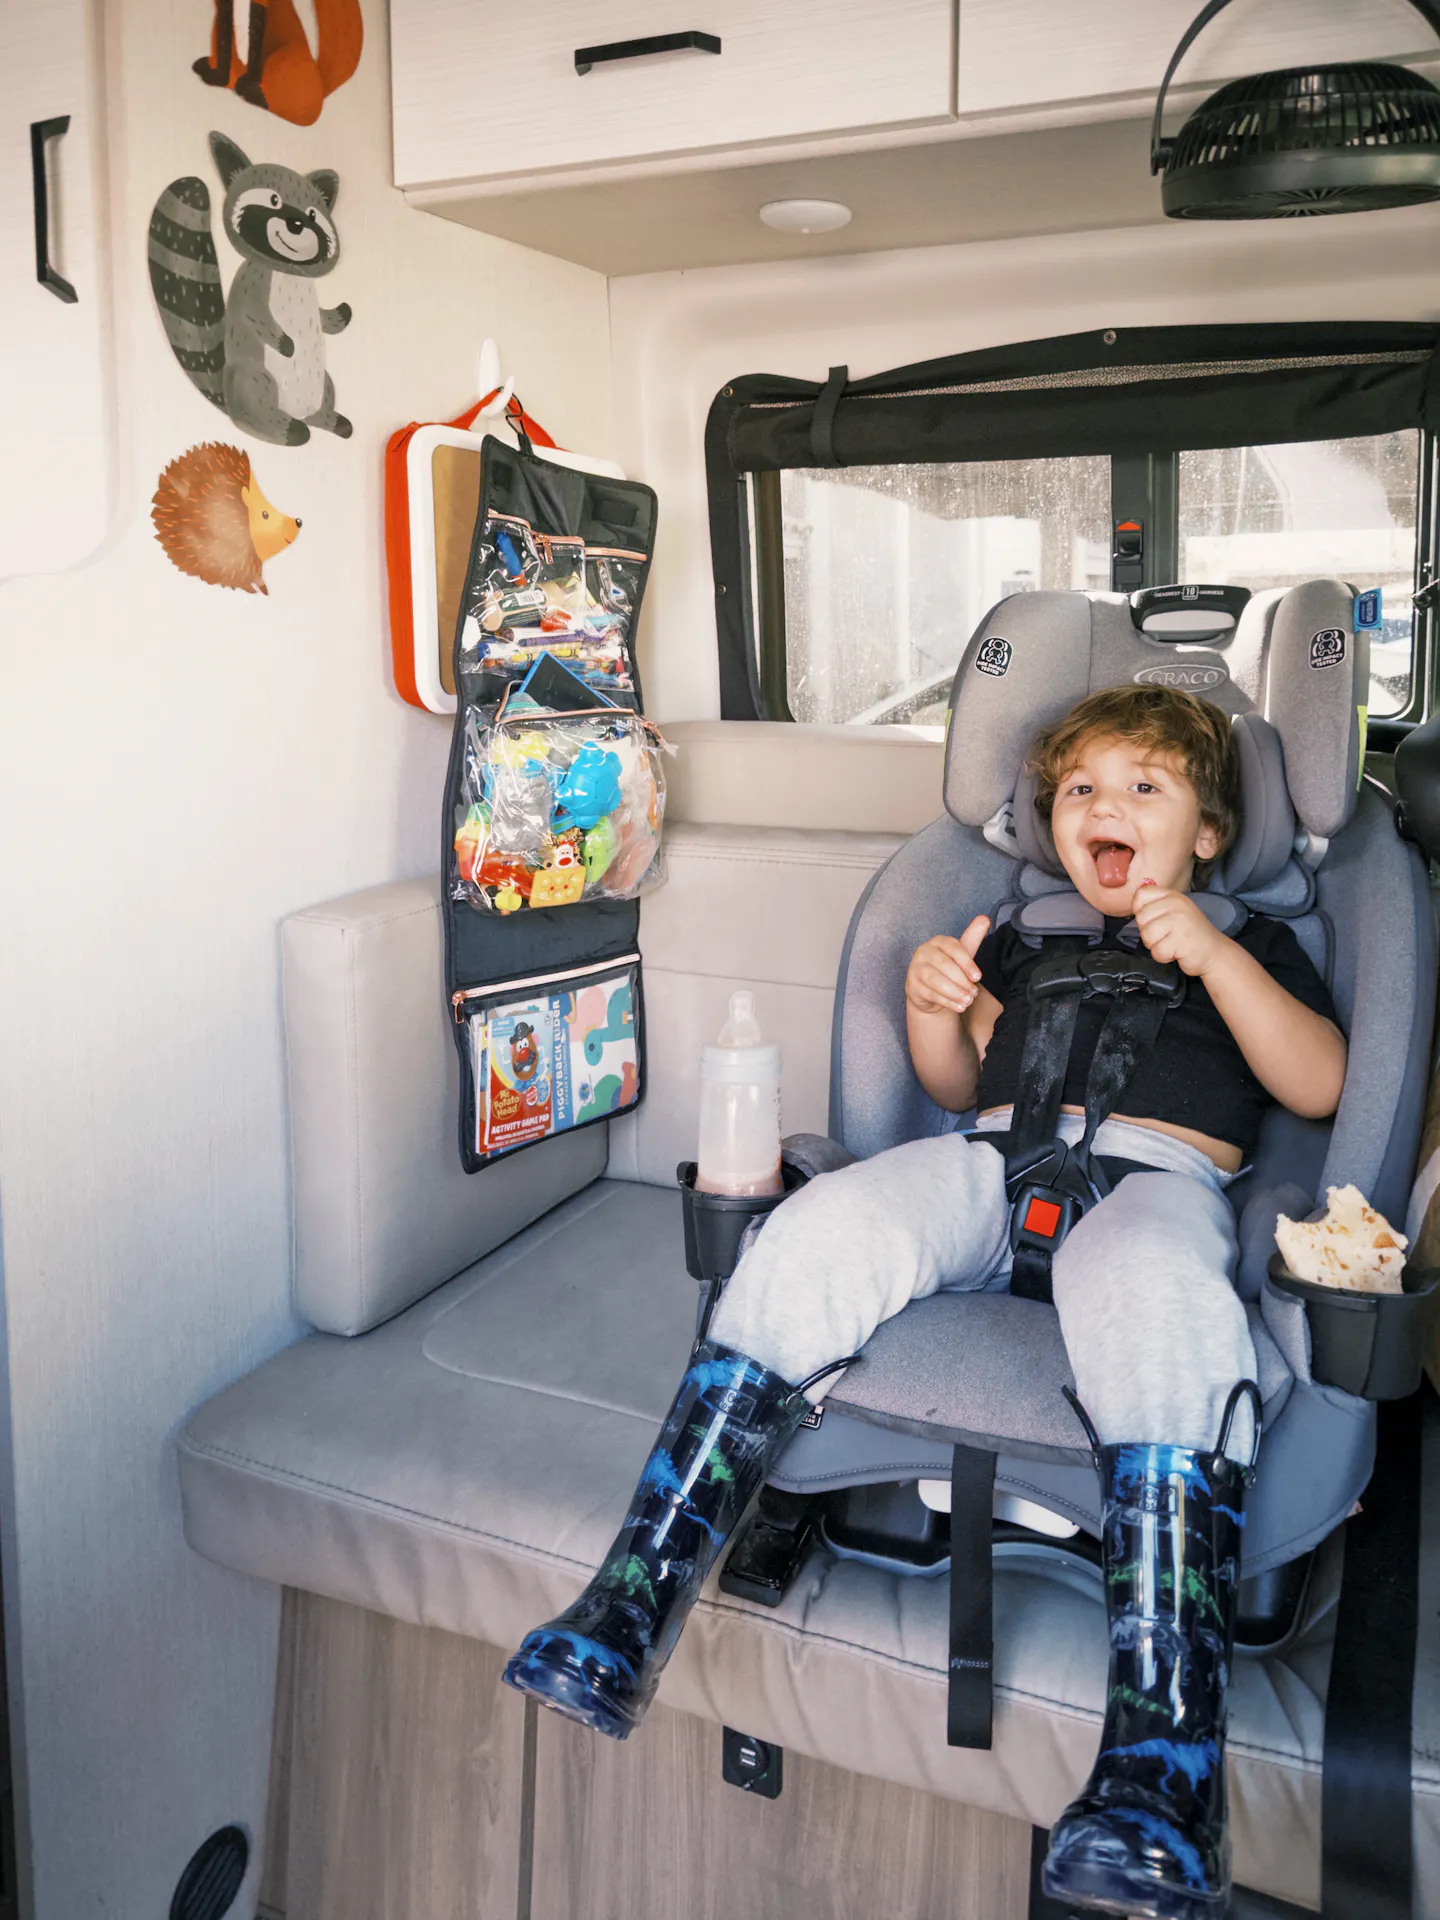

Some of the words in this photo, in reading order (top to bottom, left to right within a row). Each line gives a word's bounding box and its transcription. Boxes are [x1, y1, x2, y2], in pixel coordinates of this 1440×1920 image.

[1186, 587, 1195, 596] 10
[1322, 652, 1343, 660] IMPACT
[988, 662, 1006, 673] IMPACT
[1316, 658, 1337, 667] TESTED
[981, 665, 999, 675] TESTED
[1147, 670, 1219, 686] GRACO
[493, 1096, 520, 1109] Potato
[496, 1103, 518, 1118] Head
[491, 1120, 522, 1135] ACTIVITY
[521, 1116, 538, 1128] GAME
